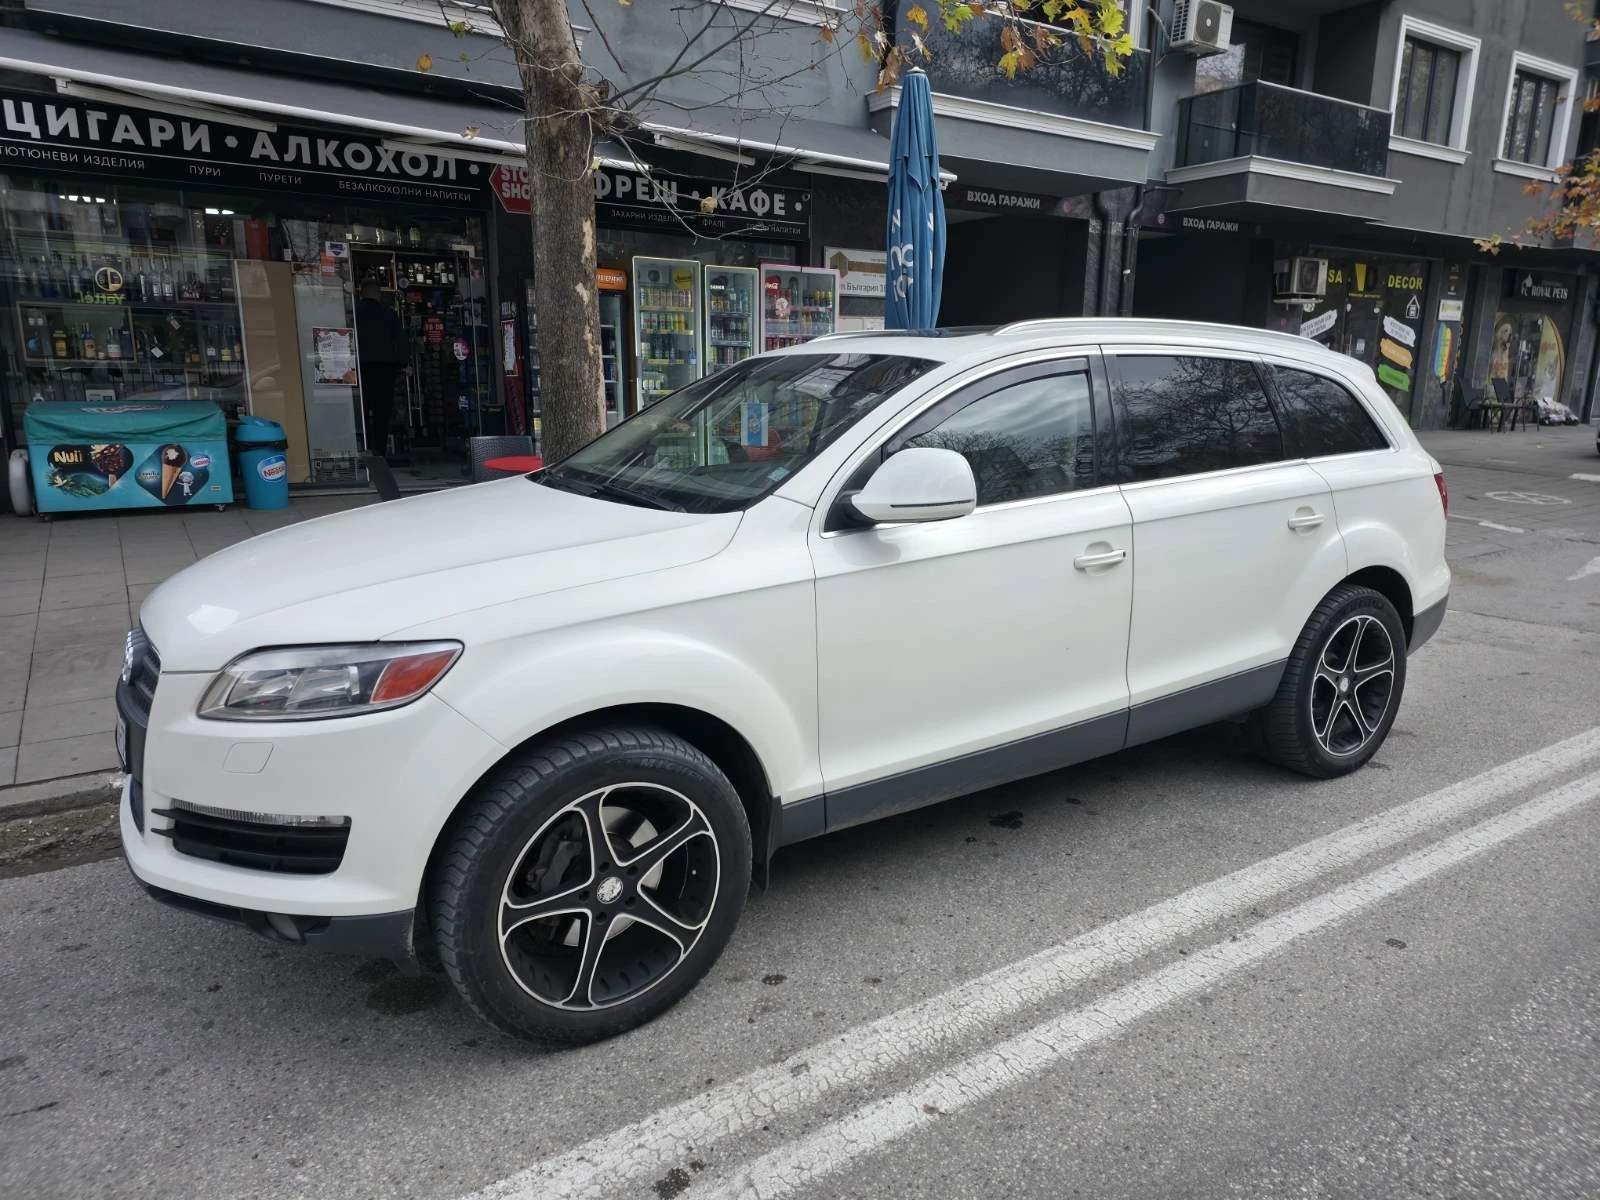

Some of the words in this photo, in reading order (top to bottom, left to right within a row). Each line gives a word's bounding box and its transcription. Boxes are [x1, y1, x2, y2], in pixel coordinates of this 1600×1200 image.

[3, 99, 211, 153] ЦИГАРИ
[250, 131, 457, 181] АЛКОХОЛ
[0, 144, 78, 163] ТЮТЮНЕВИ
[84, 154, 145, 169] ИЗДЕЛИЯ
[189, 165, 221, 177] ПУРИ
[259, 172, 302, 185] ПУРЕТИ
[500, 164, 529, 183] STO
[338, 180, 422, 196] БЕЗАЛКОХОЛНИ
[425, 188, 471, 201] НАПИТКИ
[502, 182, 531, 201] SHO
[967, 190, 997, 207] ВХОД
[998, 195, 1041, 209] ГАРАЖИ
[711, 186, 786, 216] КАФЕ
[1182, 216, 1205, 230] ВХОД
[1206, 219, 1239, 233] ГАРАЖИ
[1388, 274, 1424, 291] DECOR
[1552, 287, 1569, 300] PETS
